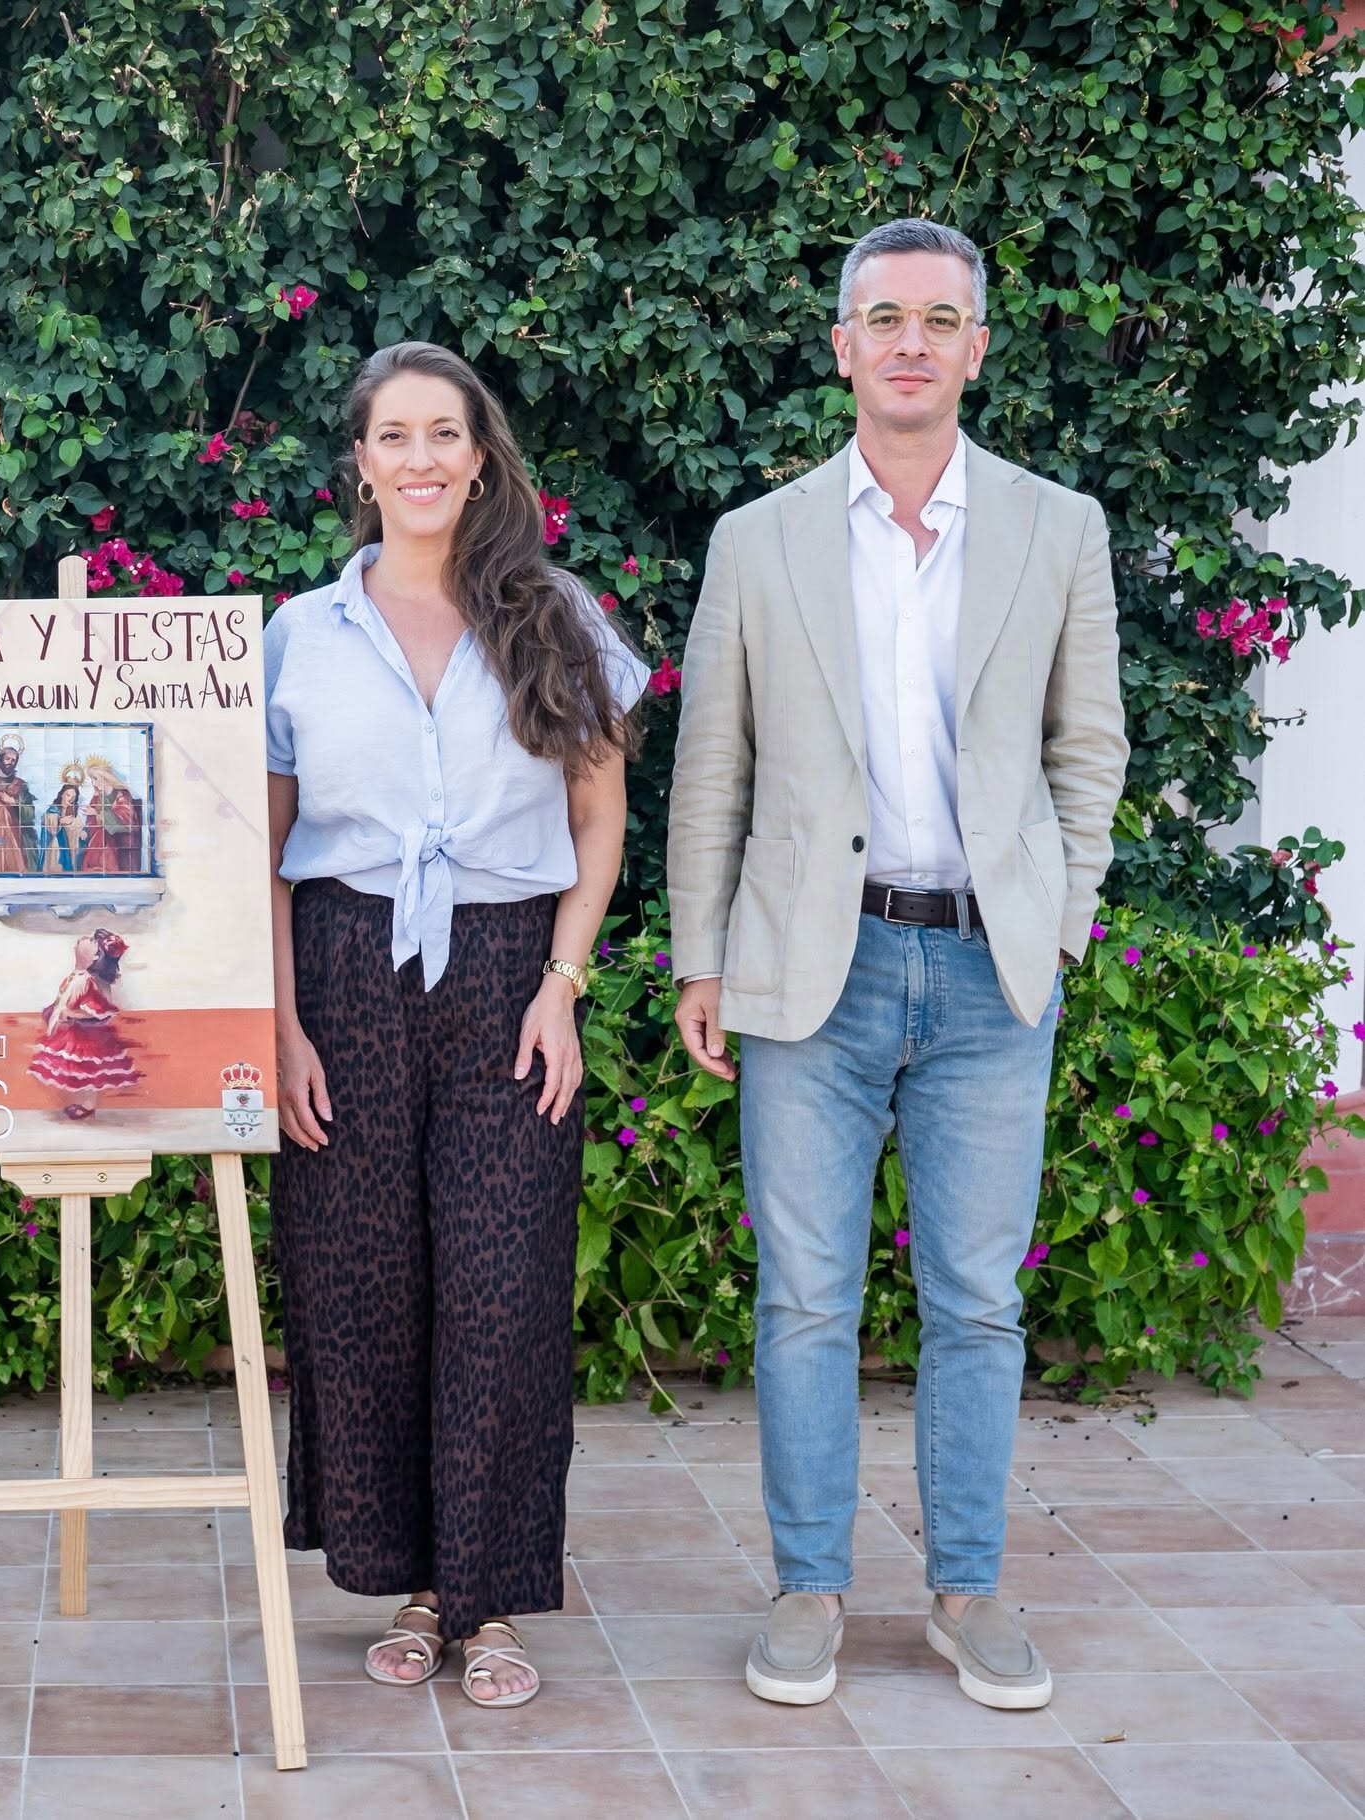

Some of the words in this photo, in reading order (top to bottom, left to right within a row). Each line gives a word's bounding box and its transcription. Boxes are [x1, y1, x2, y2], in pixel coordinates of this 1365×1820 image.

[29, 614, 56, 661] Y
[82, 609, 248, 663] FIESTAS
[84, 664, 103, 710] Y
[114, 663, 194, 710] SANTA
[200, 663, 253, 709] ANA
